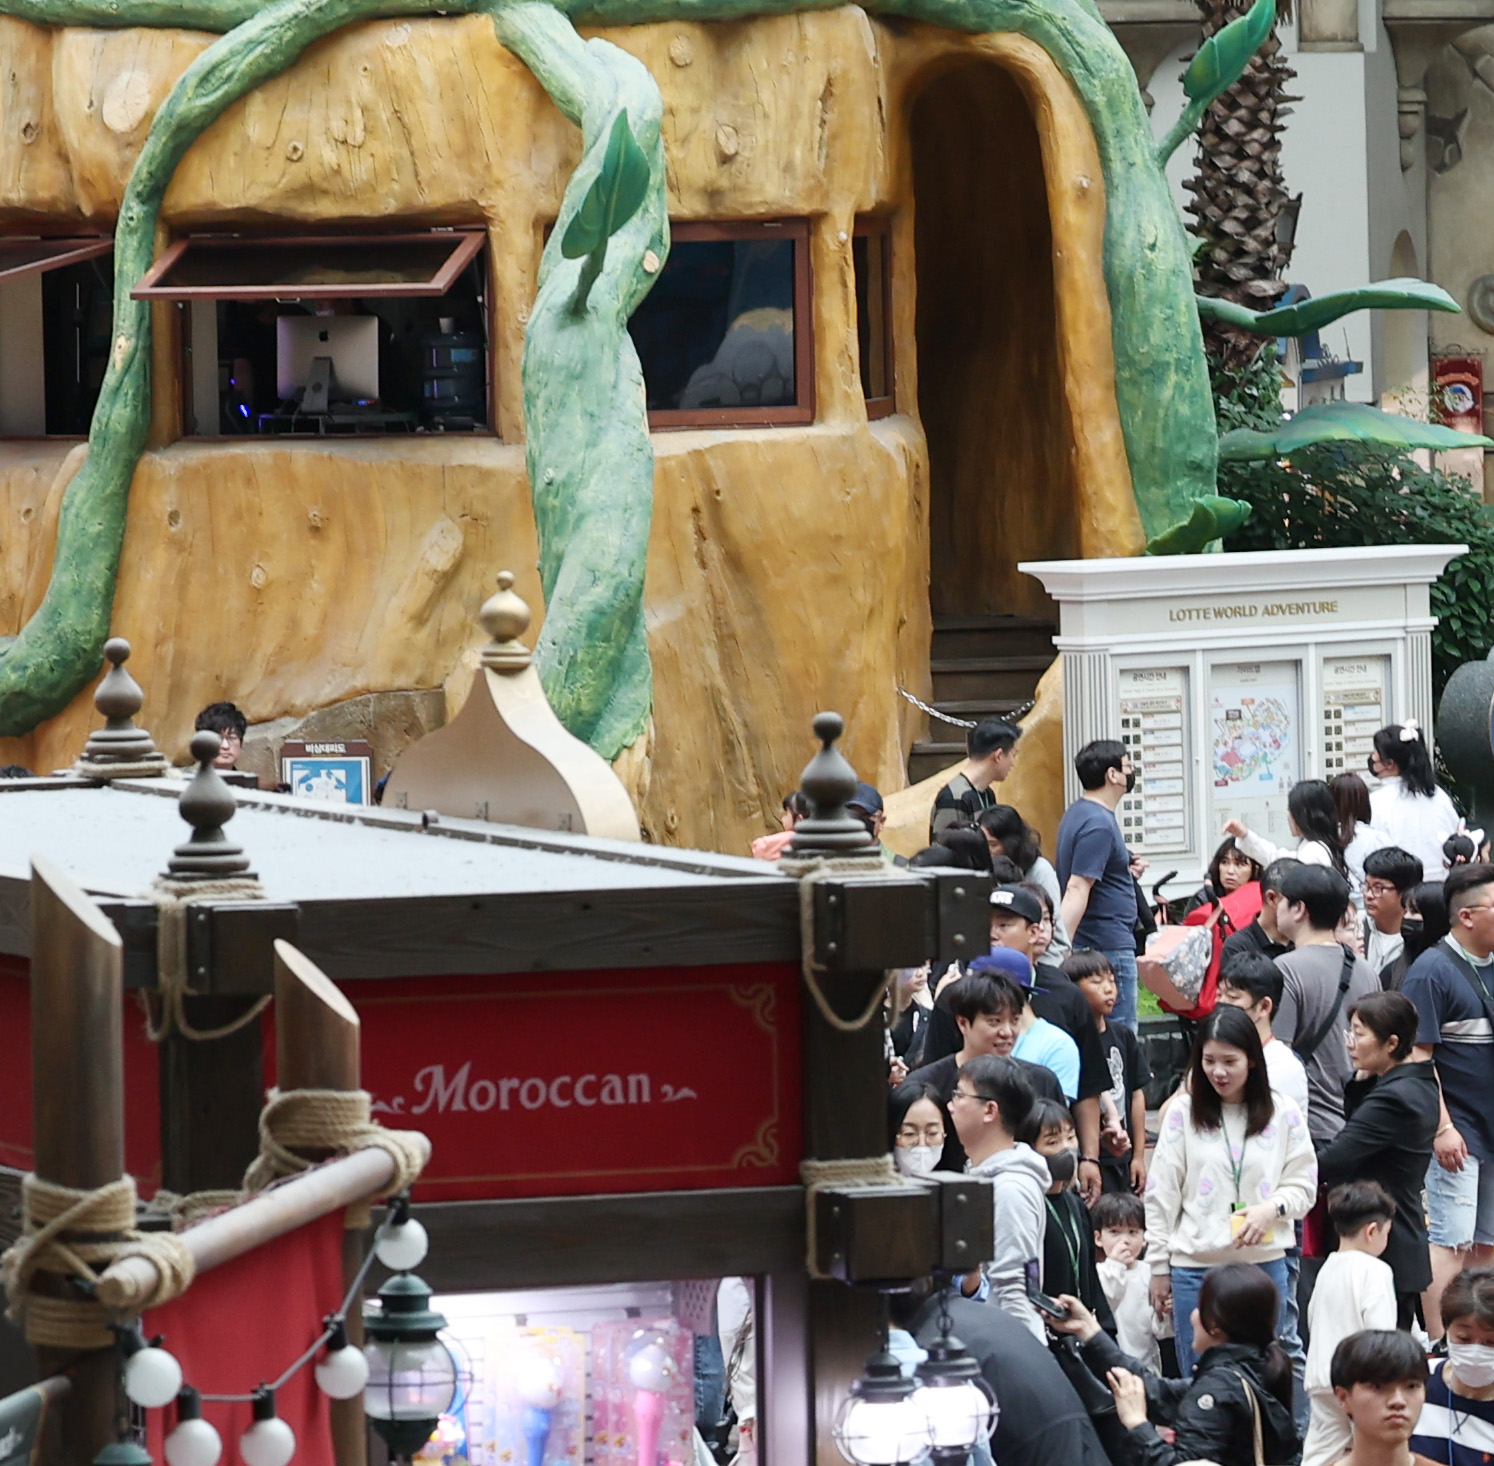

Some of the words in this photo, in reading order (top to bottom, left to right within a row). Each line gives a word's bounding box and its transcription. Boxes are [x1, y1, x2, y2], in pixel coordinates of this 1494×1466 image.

[1169, 608, 1211, 623] LOTTE
[1213, 605, 1258, 620] WORLD
[1262, 600, 1339, 617] ADVENTURE
[411, 1060, 651, 1115] Moroccan
